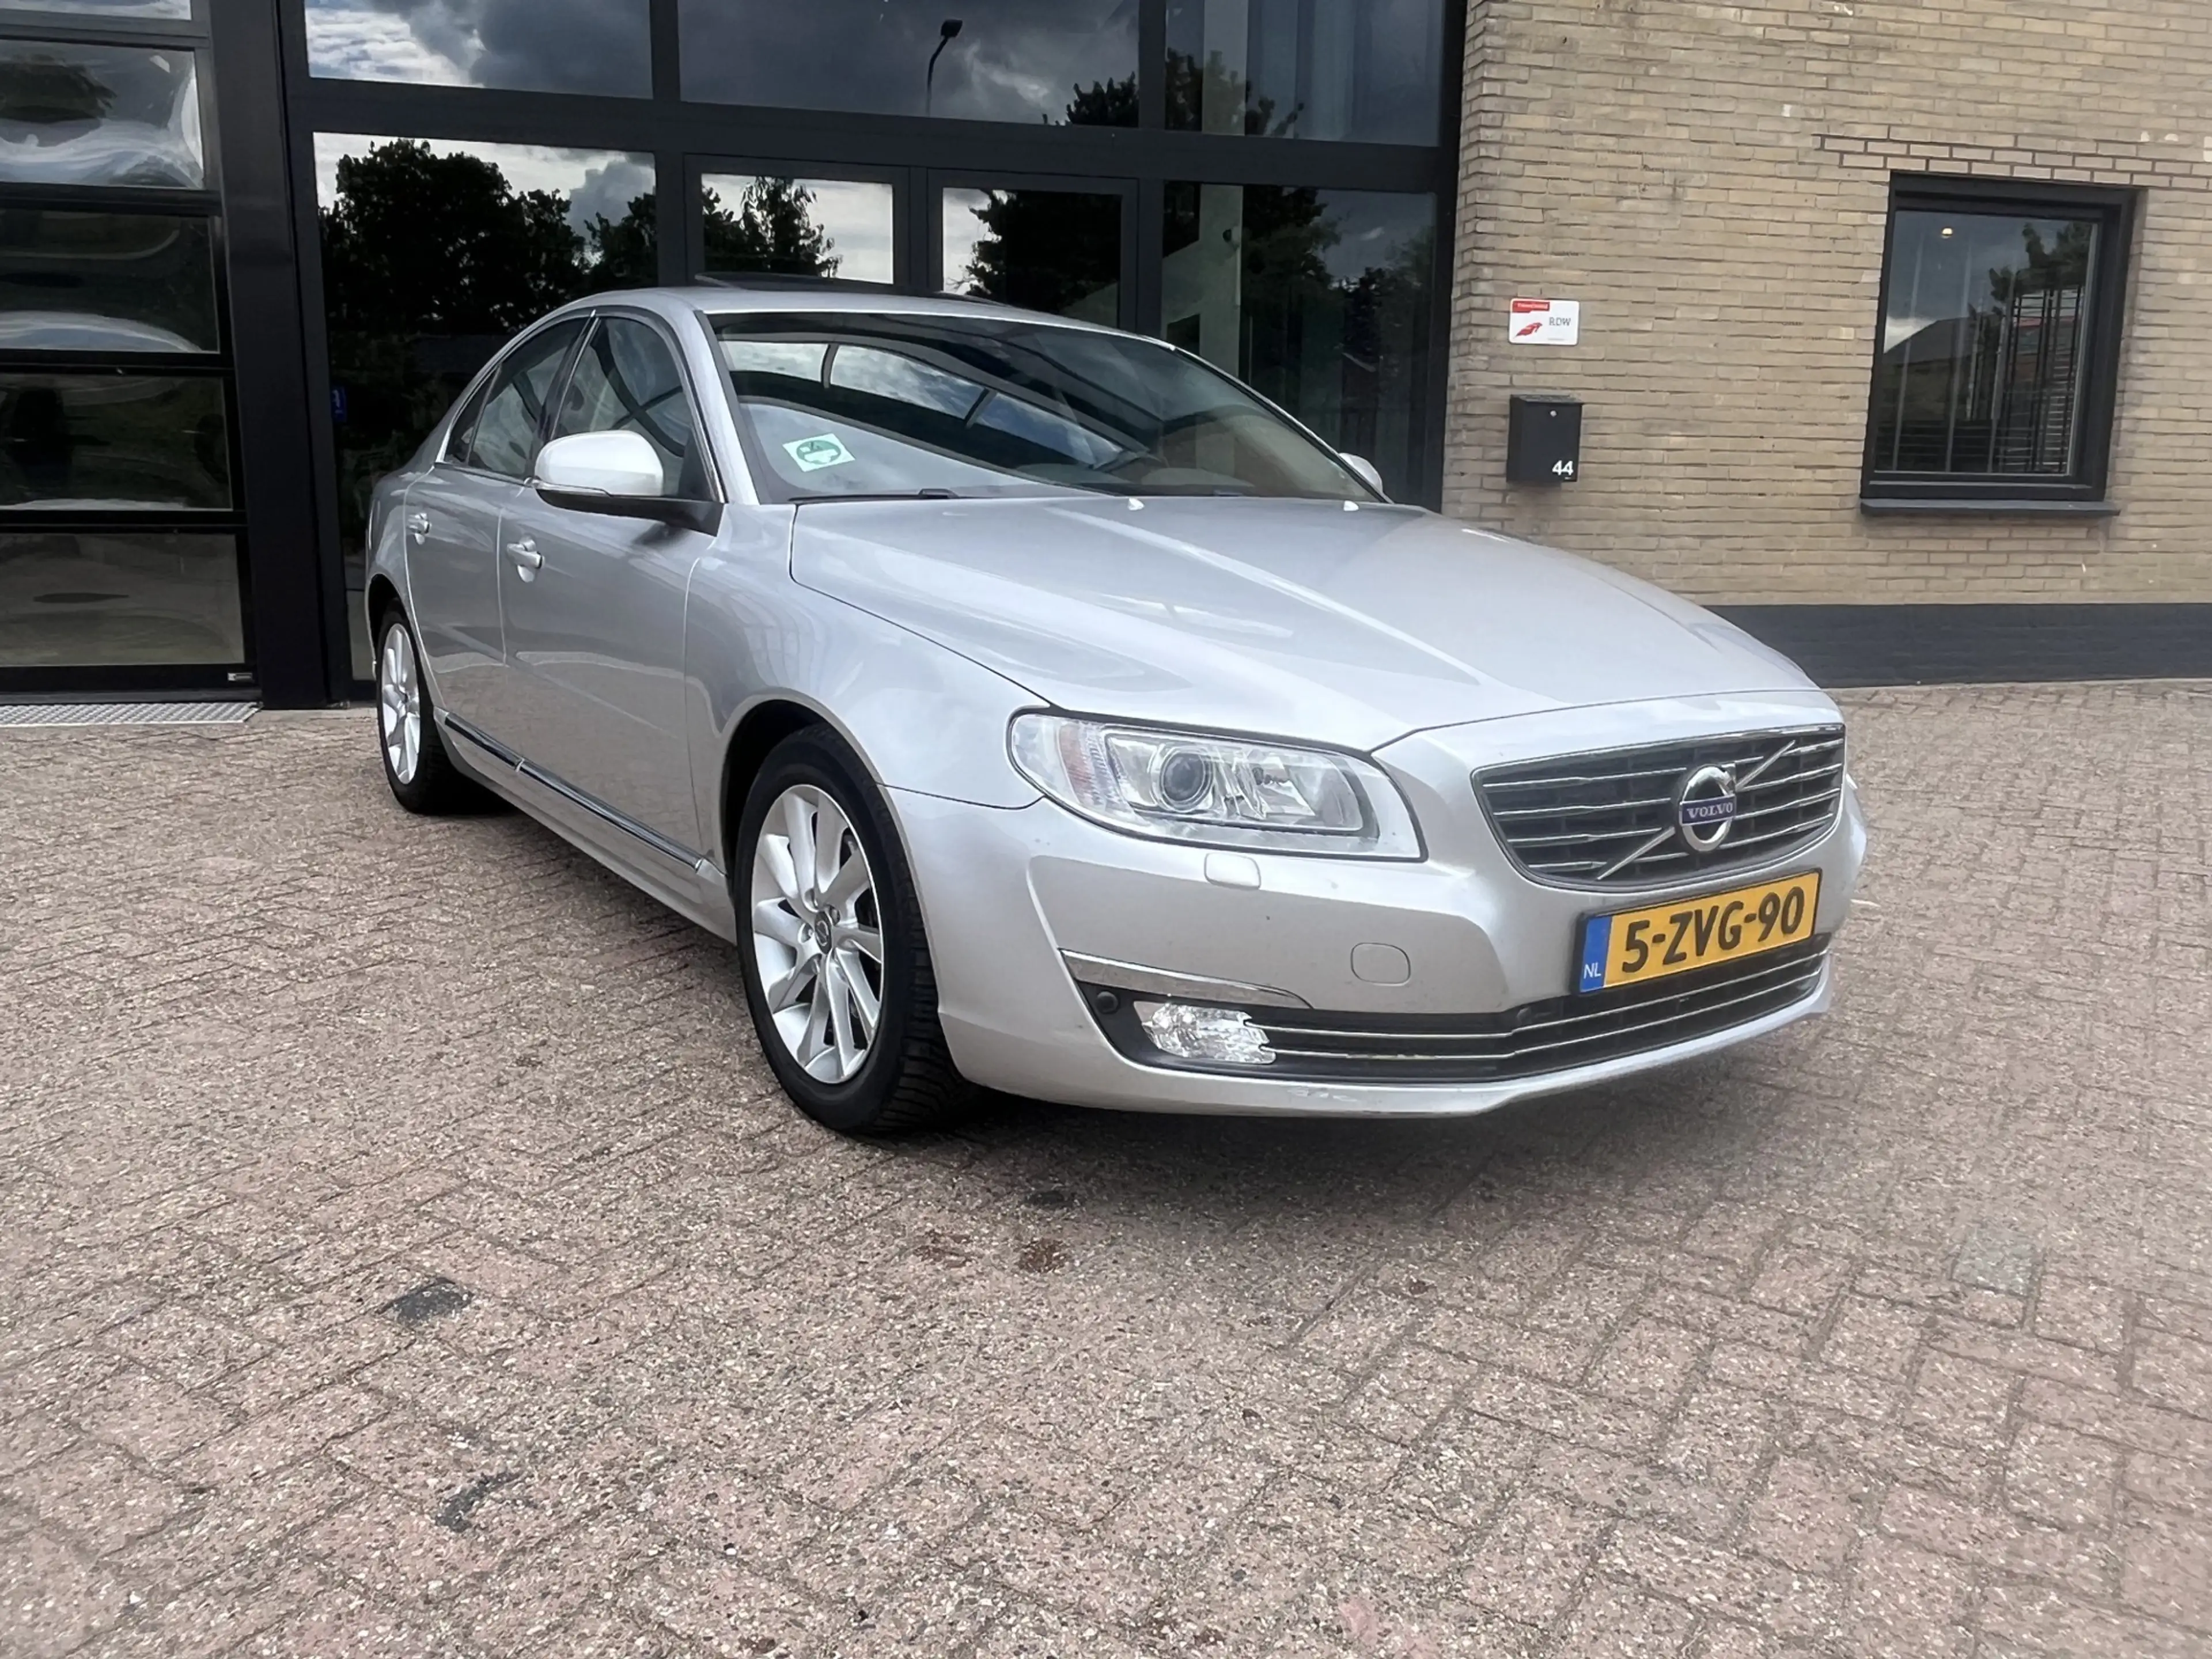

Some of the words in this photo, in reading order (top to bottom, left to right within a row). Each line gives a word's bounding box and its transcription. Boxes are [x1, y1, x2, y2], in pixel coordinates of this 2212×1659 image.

[1549, 317, 1571, 327] RDW
[1552, 460, 1574, 476] 44
[1687, 802, 1733, 819] VOLVO
[1622, 887, 1805, 974] 5-ZVG-90
[1584, 963, 1601, 979] NL
